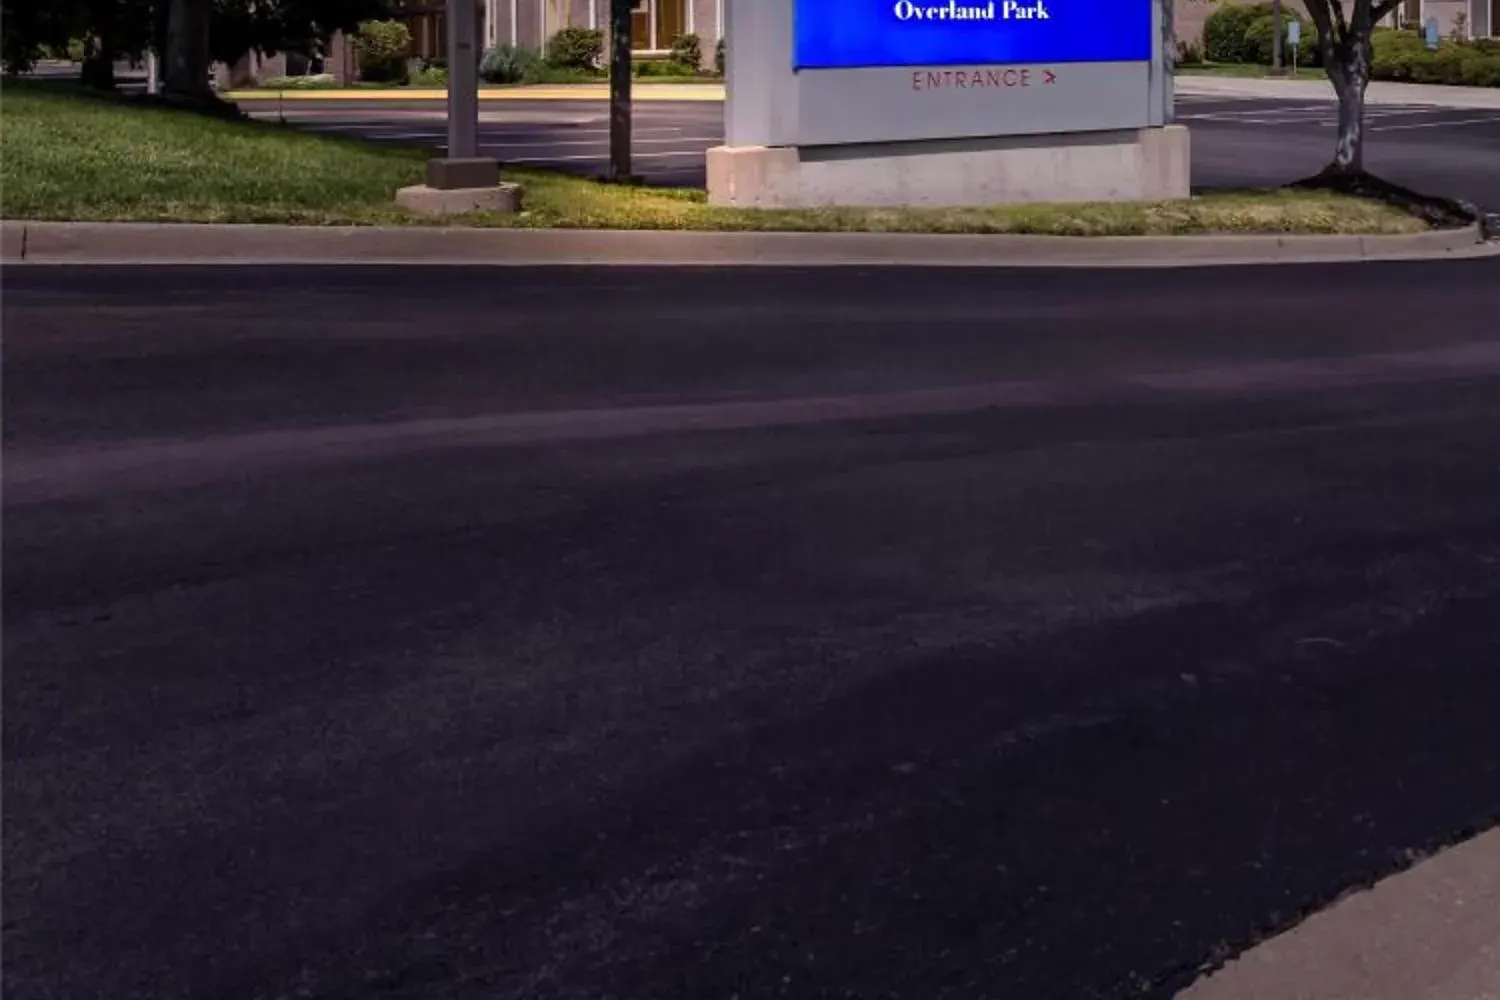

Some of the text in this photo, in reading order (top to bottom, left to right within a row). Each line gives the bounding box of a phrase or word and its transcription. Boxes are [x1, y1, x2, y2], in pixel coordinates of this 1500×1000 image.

[894, 0, 1050, 20] Overland Park
[912, 69, 1032, 90] ENTRANCE
